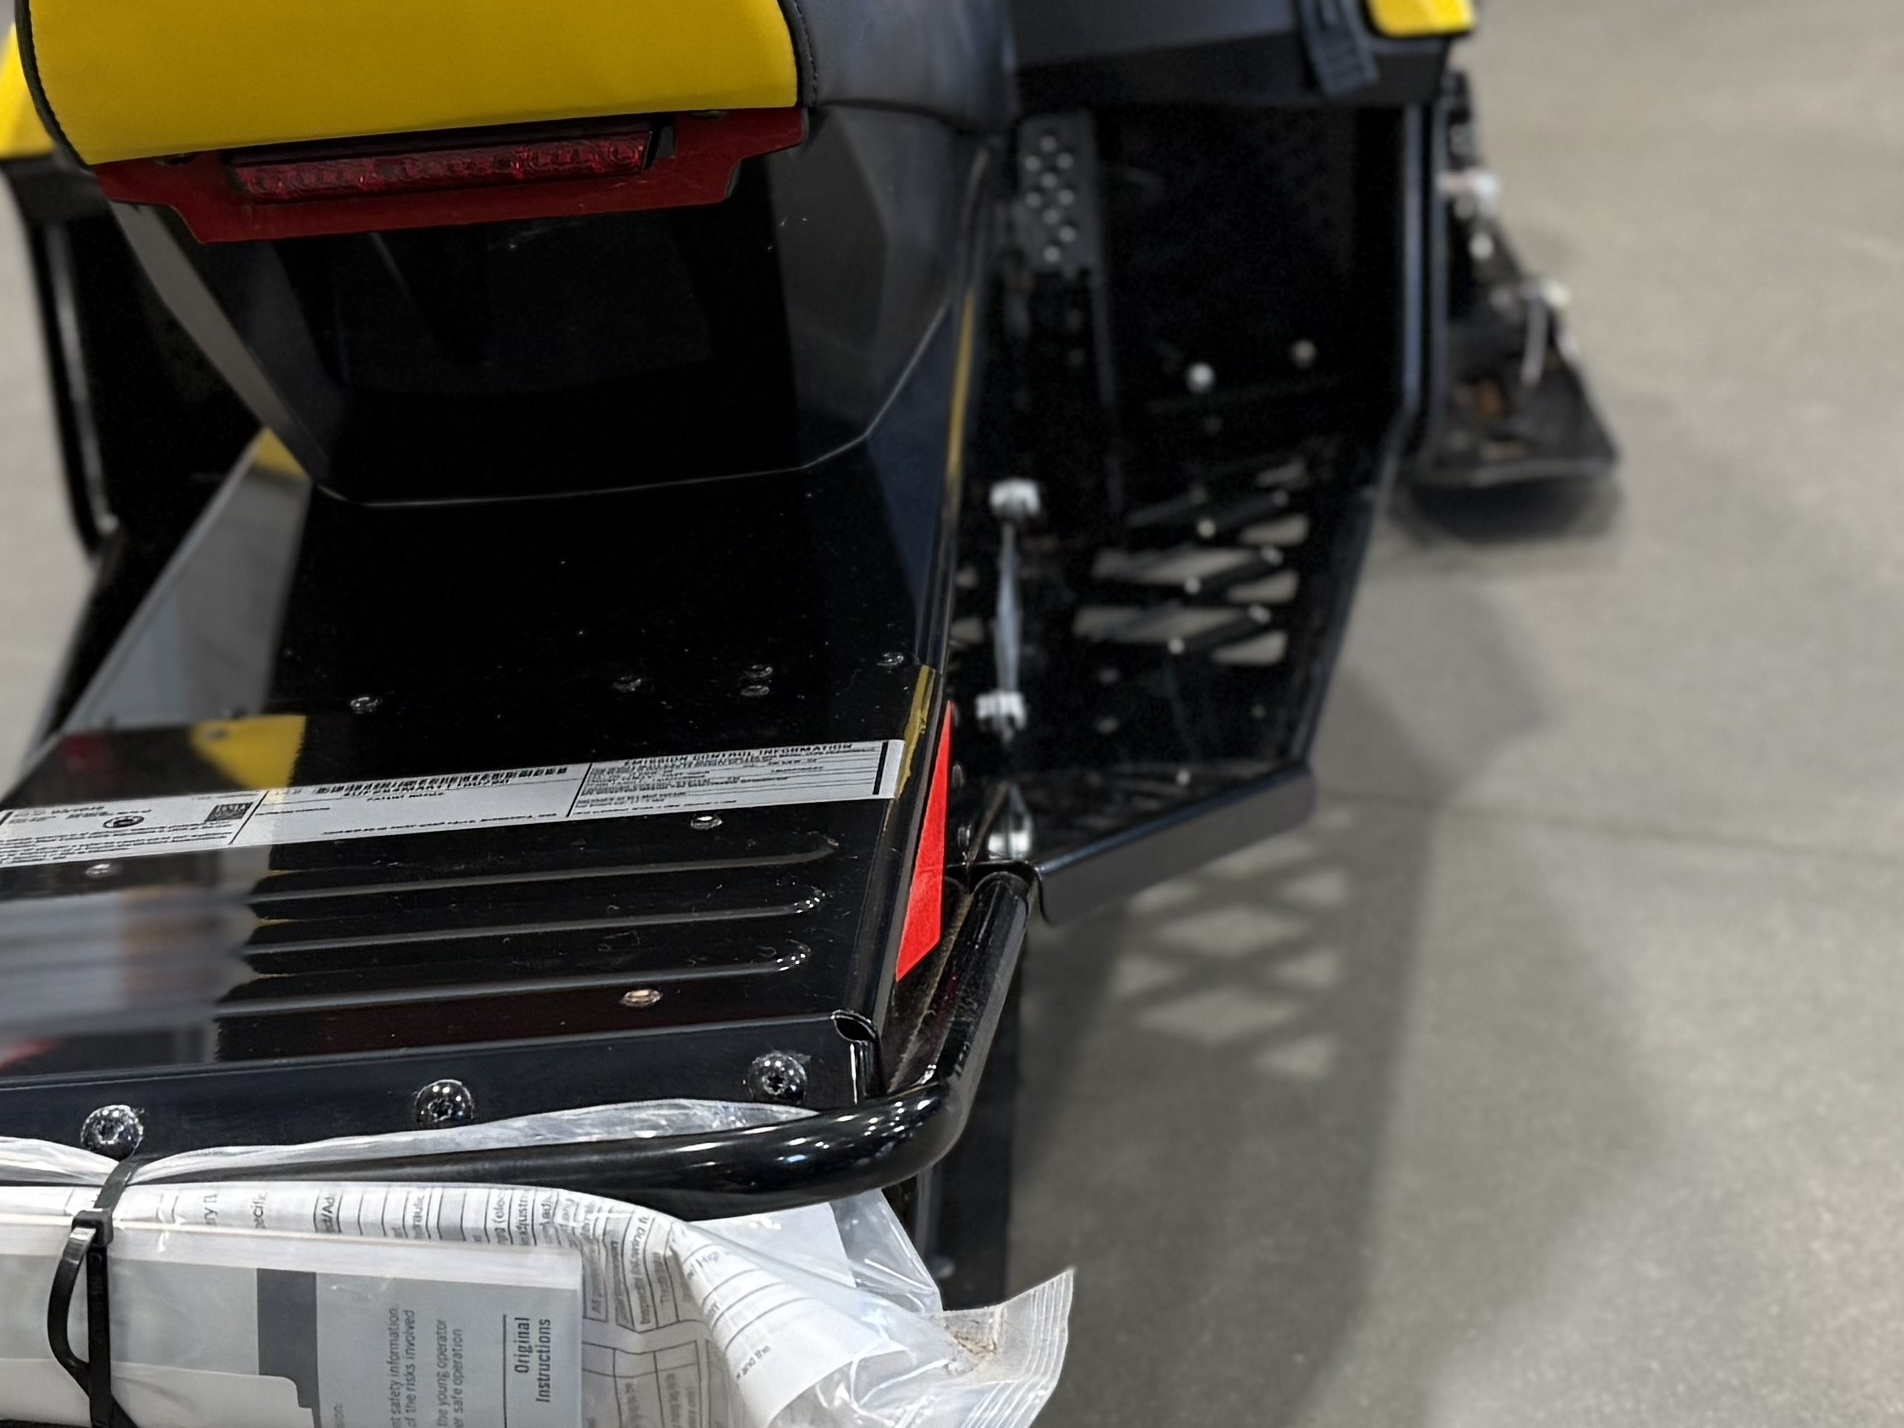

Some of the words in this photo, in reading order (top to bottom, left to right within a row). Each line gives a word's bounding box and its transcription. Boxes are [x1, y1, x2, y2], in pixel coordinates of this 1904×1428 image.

[402, 1309, 416, 1359] involved
[435, 1318, 449, 1368] operator
[513, 1317, 534, 1373] Original
[451, 1328, 465, 1386] operation
[535, 1318, 552, 1403] Instructions
[403, 1363, 416, 1391] risks
[436, 1371, 451, 1406] young
[387, 1380, 404, 1414] safety
[403, 1395, 417, 1413] the
[451, 1387, 465, 1413] safe
[436, 1409, 448, 1426] the
